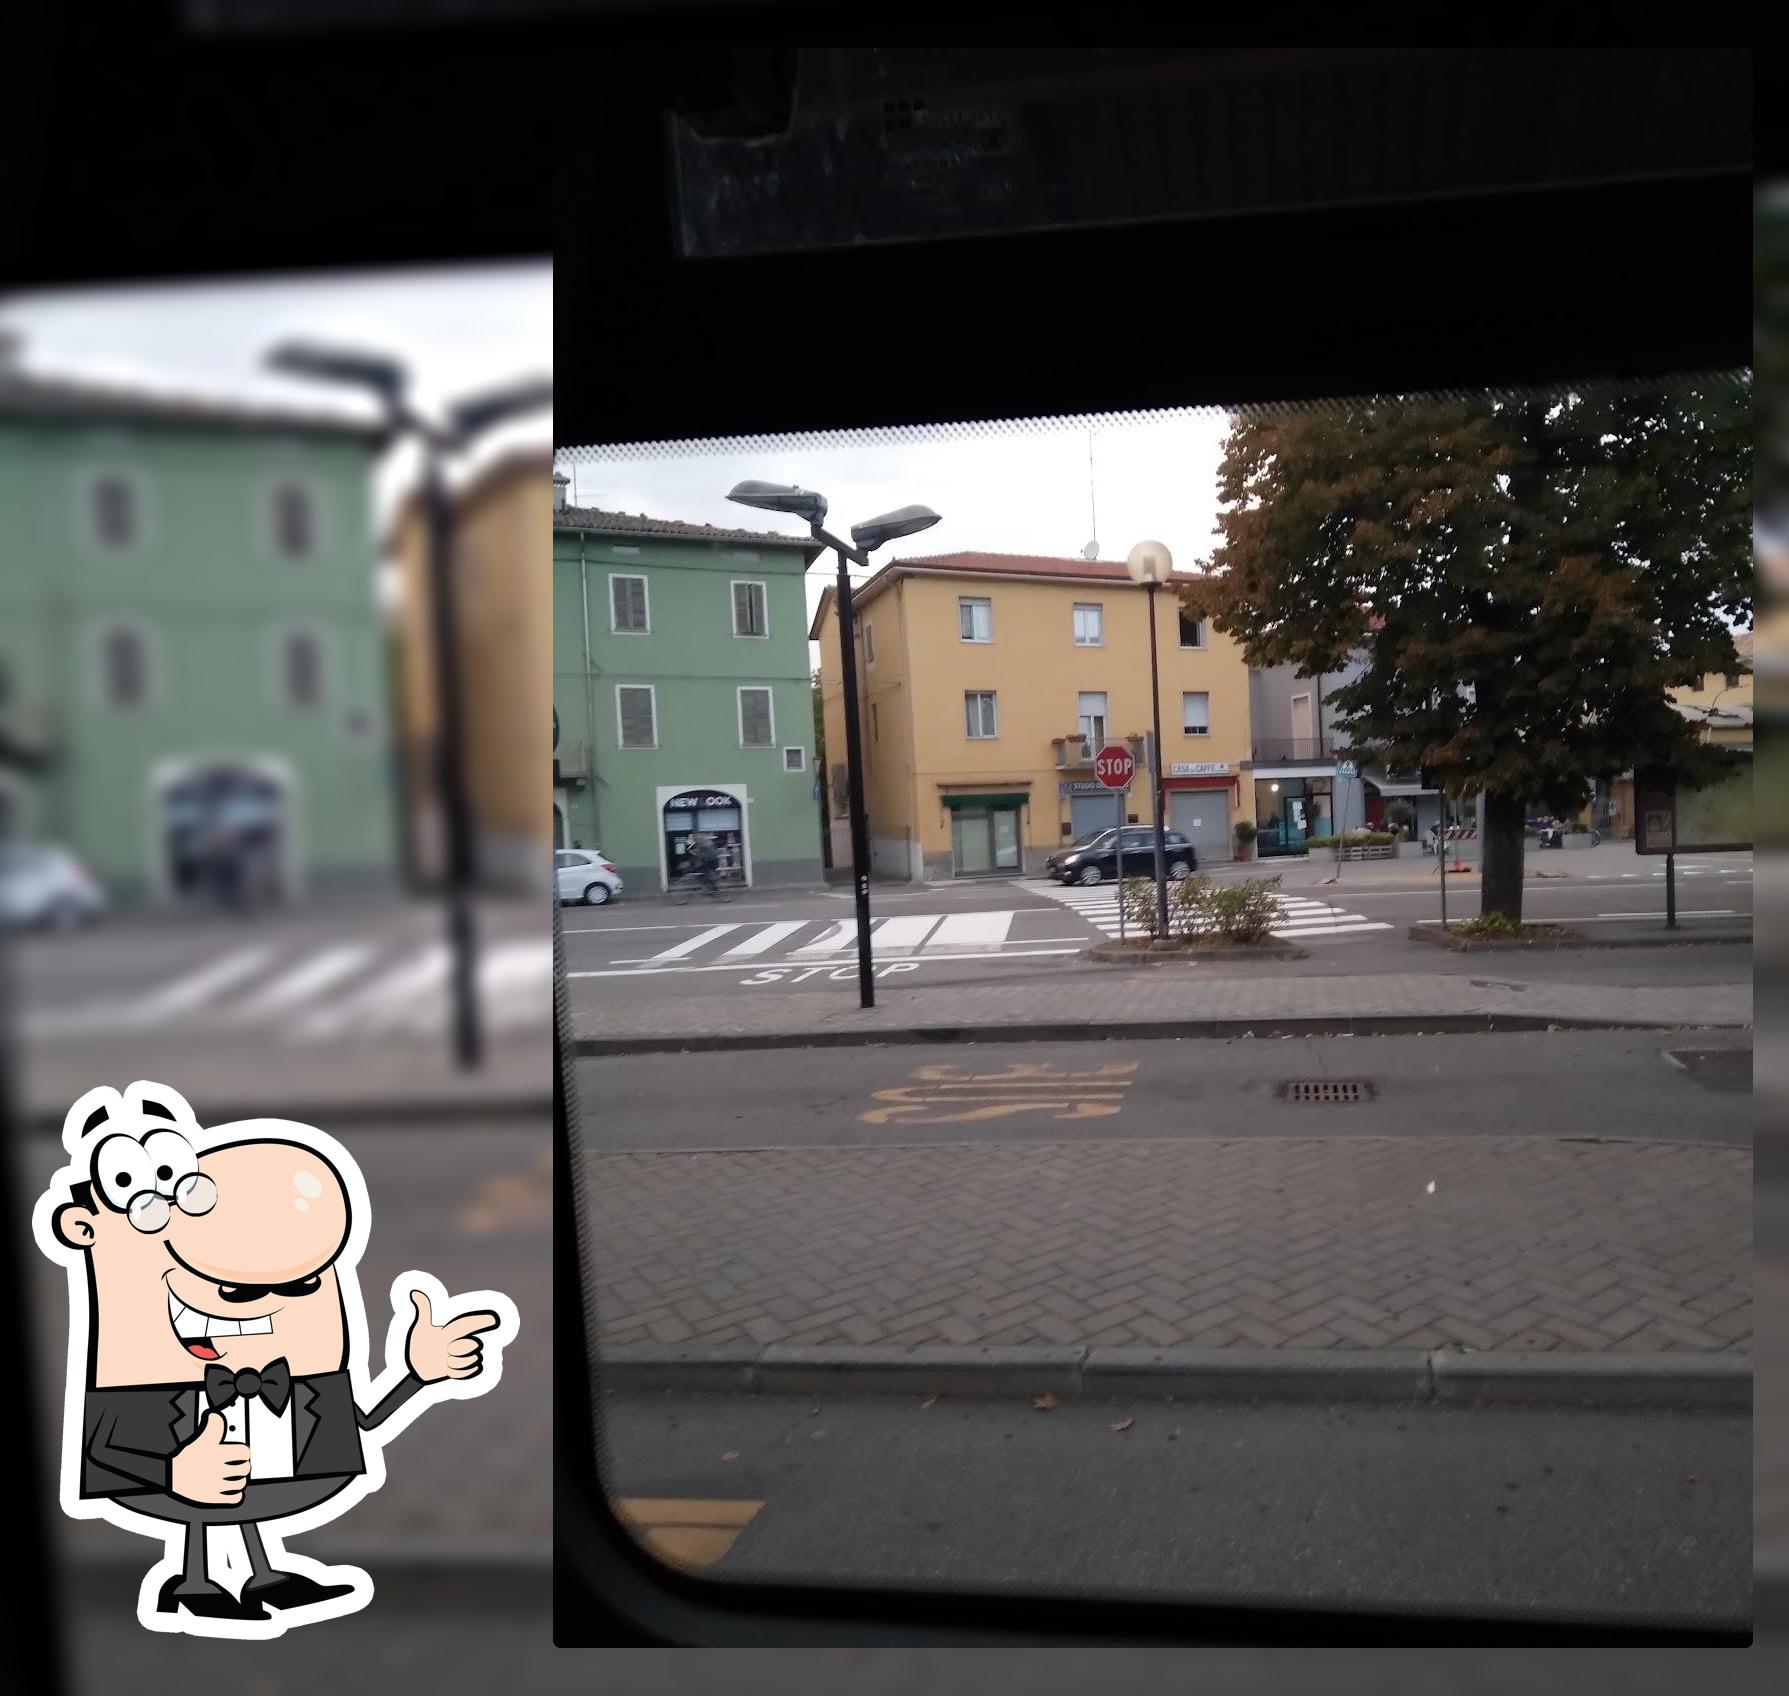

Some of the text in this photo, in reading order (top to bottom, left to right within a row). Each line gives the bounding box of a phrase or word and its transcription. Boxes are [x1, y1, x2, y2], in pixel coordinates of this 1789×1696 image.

[1097, 758, 1133, 776] STOP
[1073, 782, 1096, 791] STUDIO
[669, 796, 732, 808] NEW OOK
